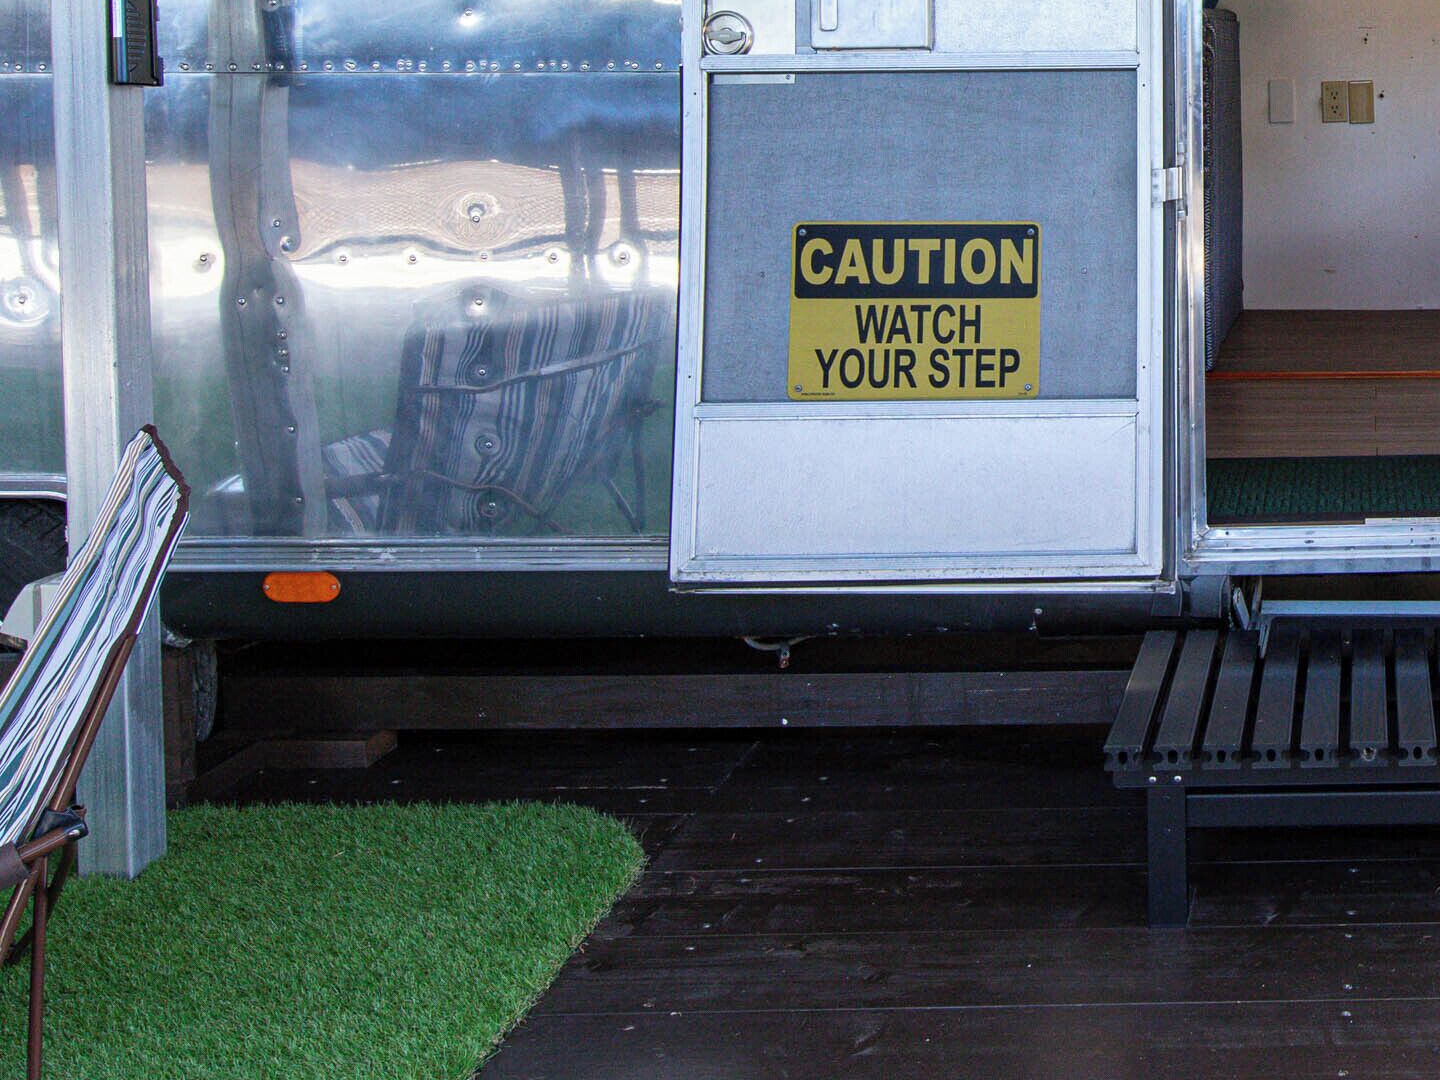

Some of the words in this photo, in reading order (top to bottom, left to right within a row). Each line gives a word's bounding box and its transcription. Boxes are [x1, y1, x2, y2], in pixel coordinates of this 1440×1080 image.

[800, 238, 1034, 285] CAUTION
[855, 304, 981, 344] WATCH
[815, 348, 917, 388] YOUR
[928, 348, 1020, 388] STEP
